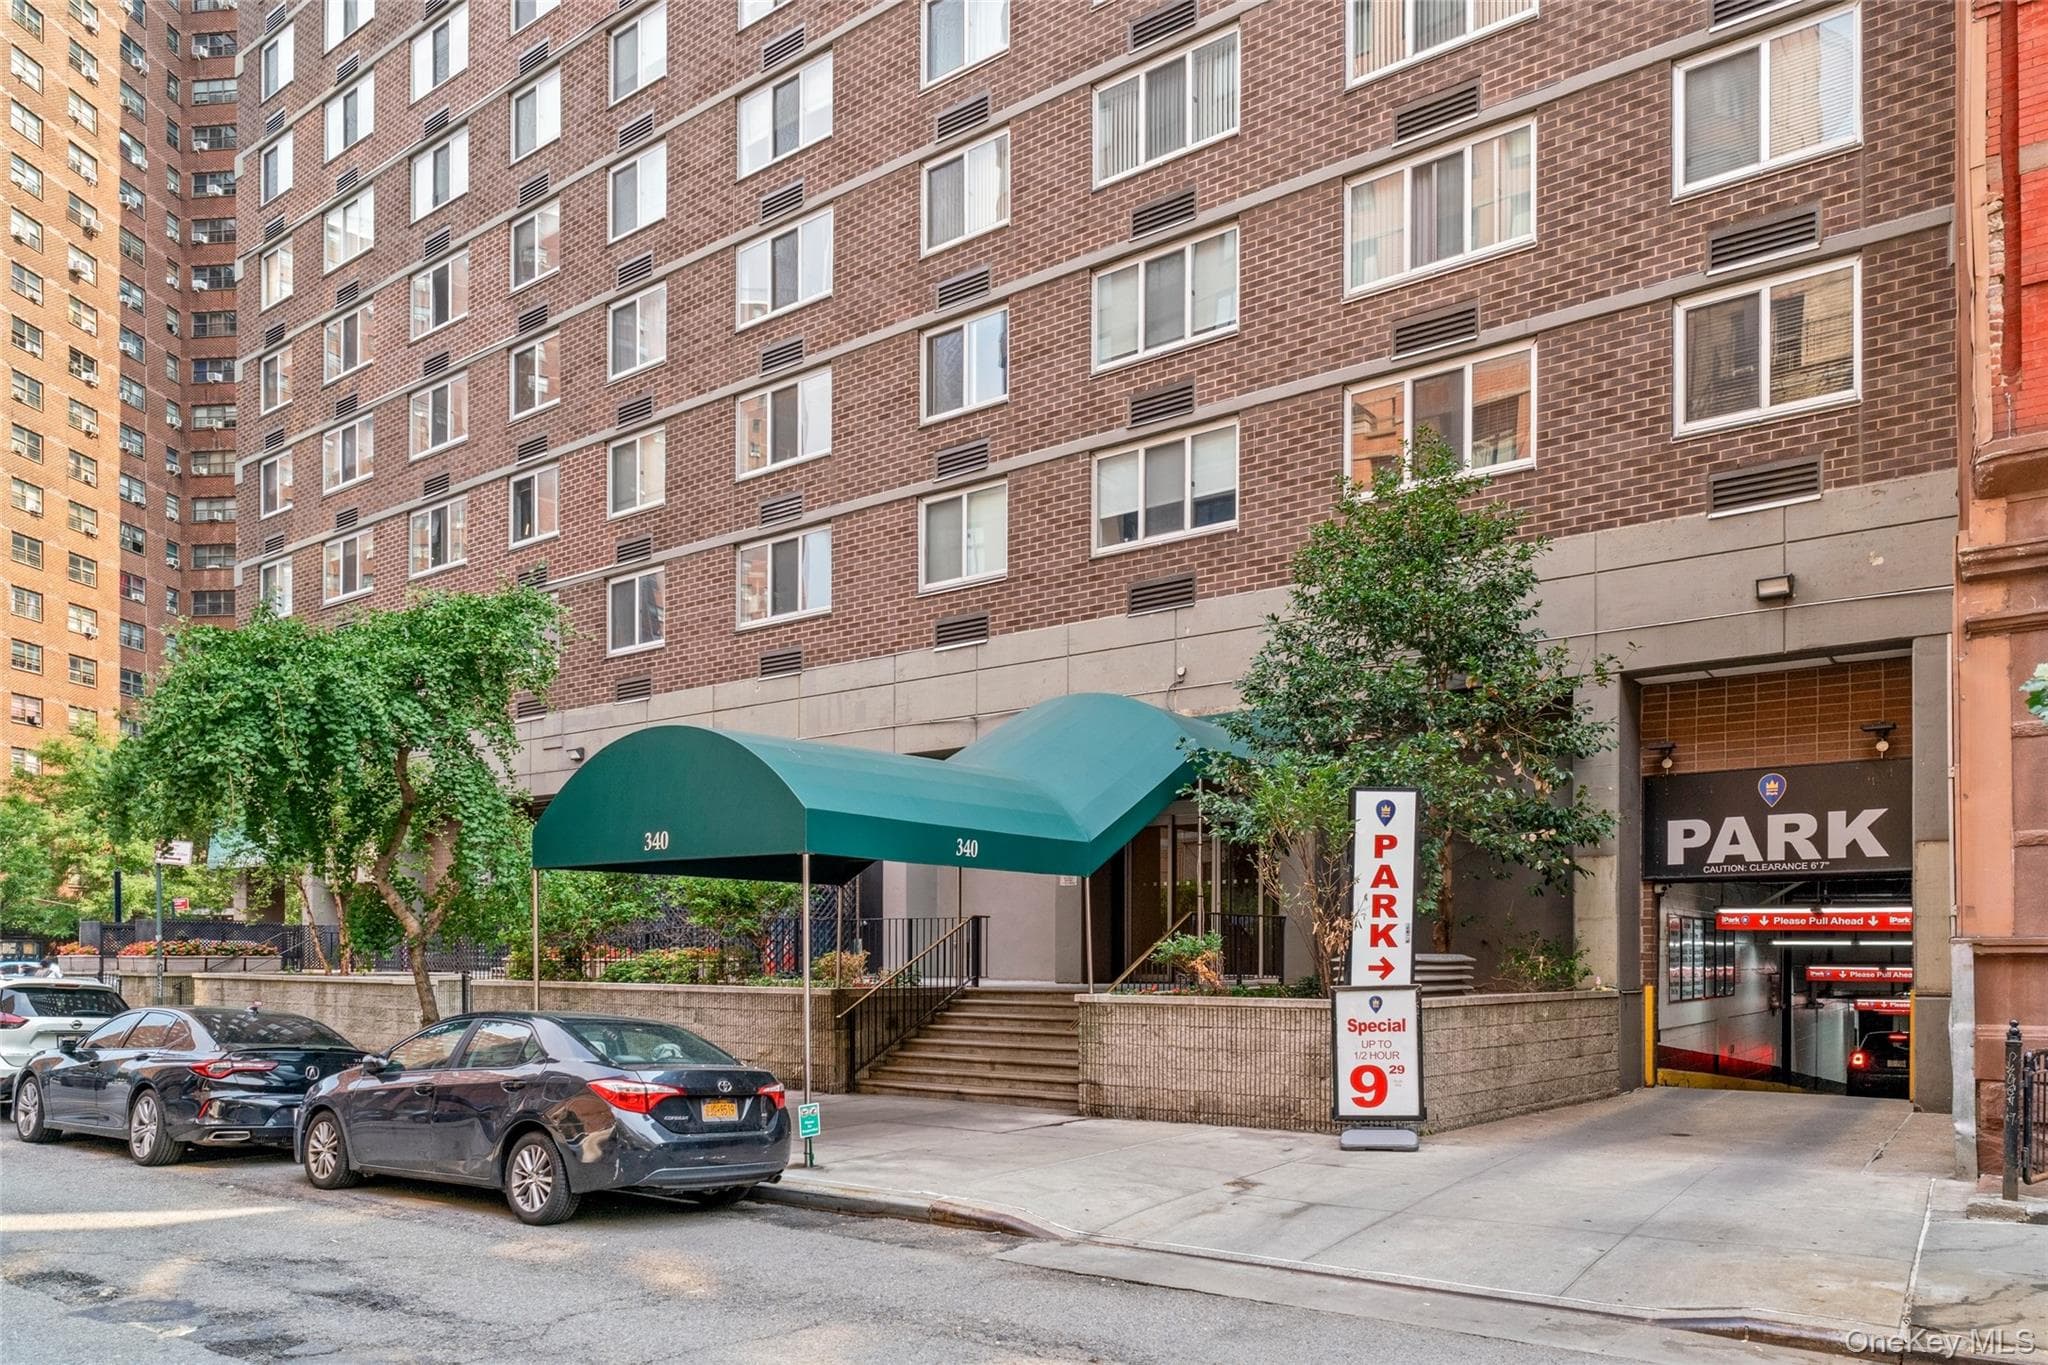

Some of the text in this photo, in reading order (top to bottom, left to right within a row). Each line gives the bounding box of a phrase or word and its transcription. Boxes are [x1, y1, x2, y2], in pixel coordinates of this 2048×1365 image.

[644, 831, 669, 851] 340
[1667, 808, 1889, 865] PARK
[956, 838, 978, 857] 340
[1703, 864, 1747, 874] CAUTION:
[1750, 862, 1808, 872] CLEARANCE
[1370, 834, 1399, 948] PARK
[1773, 917, 1864, 925] Please Pull Ahead
[1347, 1018, 1406, 1036] Special
[1361, 1040, 1392, 1049] UP TO
[1354, 1052, 1400, 1060] 1/2 HOUR
[1350, 1064, 1405, 1108] 9 29
